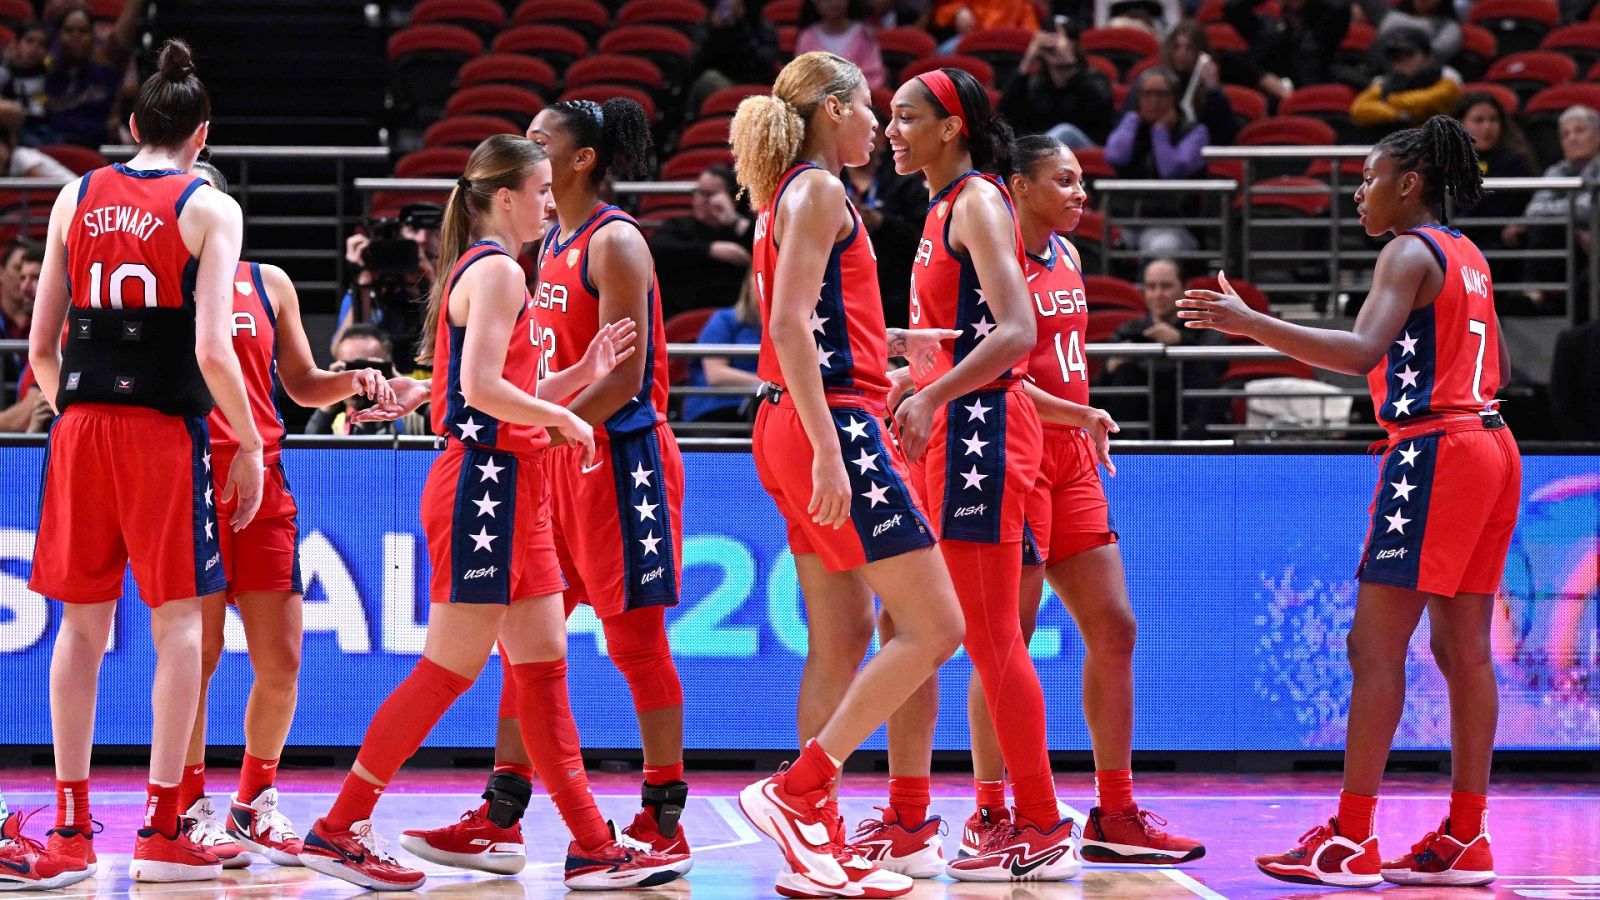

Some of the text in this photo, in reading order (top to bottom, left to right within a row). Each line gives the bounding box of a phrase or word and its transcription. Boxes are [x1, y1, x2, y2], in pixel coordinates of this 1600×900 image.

[84, 206, 165, 242] STEWART
[1033, 287, 1088, 317] USA
[1053, 330, 1086, 383] 14
[1469, 319, 1486, 403] 7
[952, 503, 988, 518] USA
[872, 513, 903, 538] USA
[1376, 546, 1409, 560] USA
[463, 565, 499, 580] USA
[641, 566, 665, 585] USA
